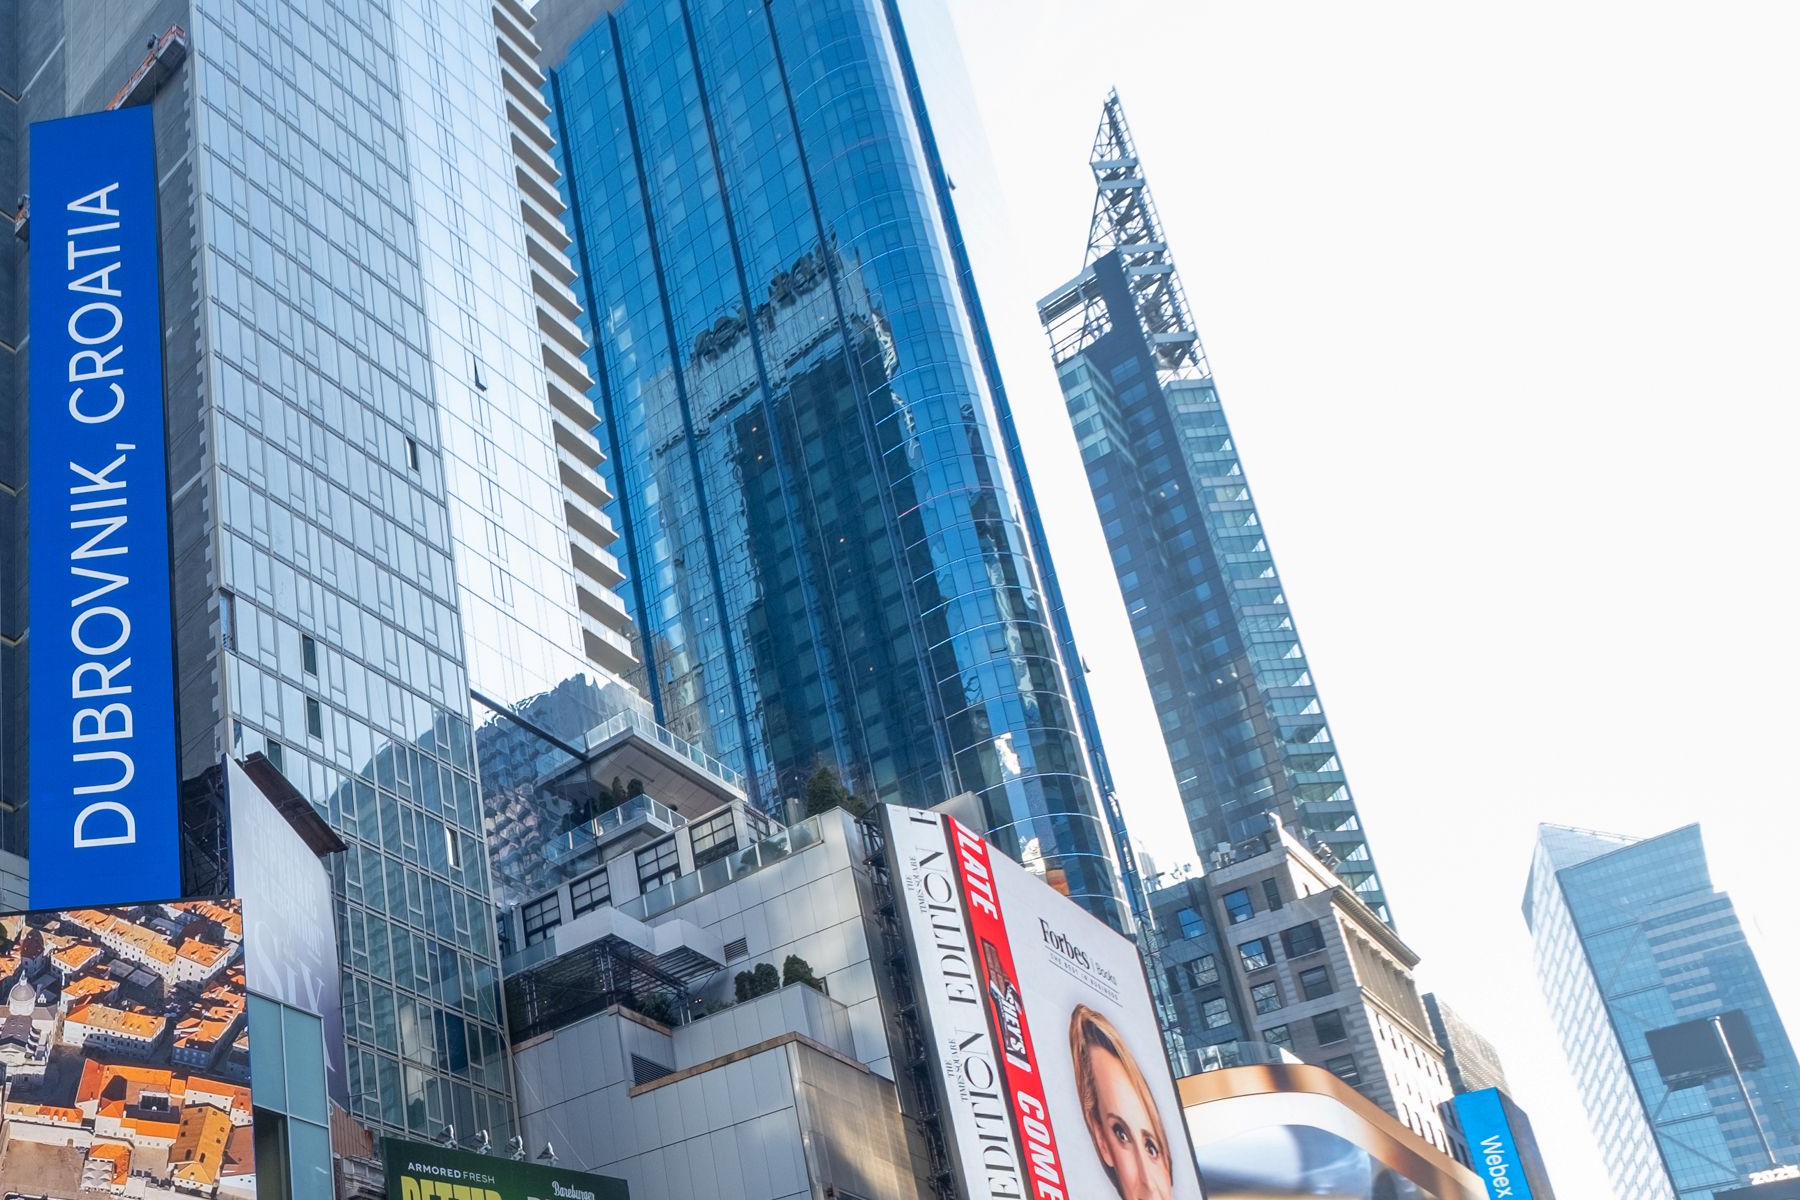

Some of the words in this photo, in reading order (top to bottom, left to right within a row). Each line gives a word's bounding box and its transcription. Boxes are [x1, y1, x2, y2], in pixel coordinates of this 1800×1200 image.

[66, 181, 126, 424] CROATIA
[70, 443, 137, 849] DUBROVNIK,
[916, 847, 978, 1005] EDITION
[1038, 917, 1090, 970] Forbes
[408, 1162, 461, 1179] ARMORED
[463, 1171, 496, 1184] FRESH
[955, 1028, 1021, 1200] EDITION
